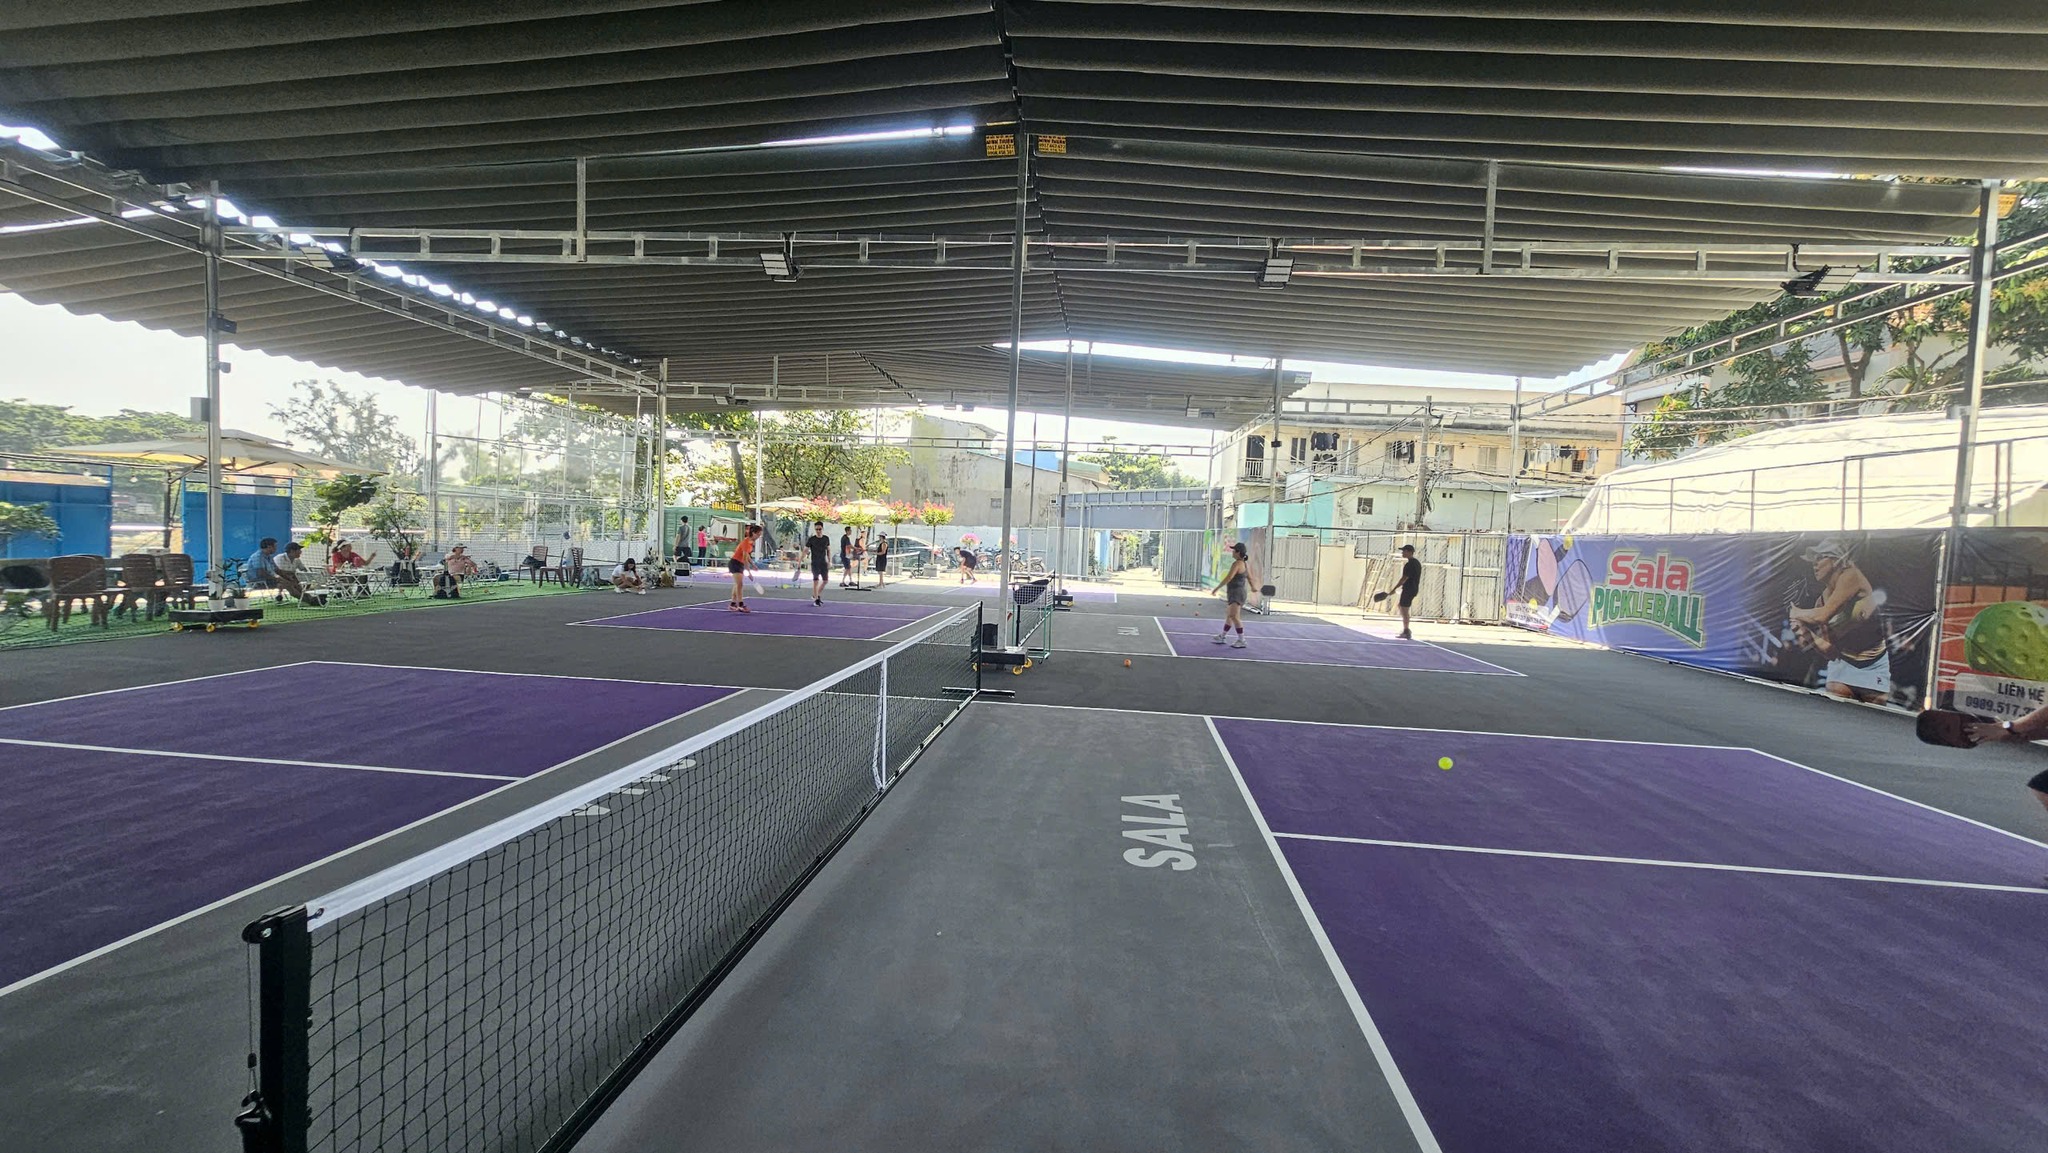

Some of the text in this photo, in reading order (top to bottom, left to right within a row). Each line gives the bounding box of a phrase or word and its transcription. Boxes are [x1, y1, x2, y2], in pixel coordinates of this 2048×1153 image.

[1609, 555, 1690, 592] Sala
[1591, 587, 1702, 642] PICKLEBALL
[1998, 682, 2025, 699] LIÊN
[1121, 794, 1197, 871] SALA
